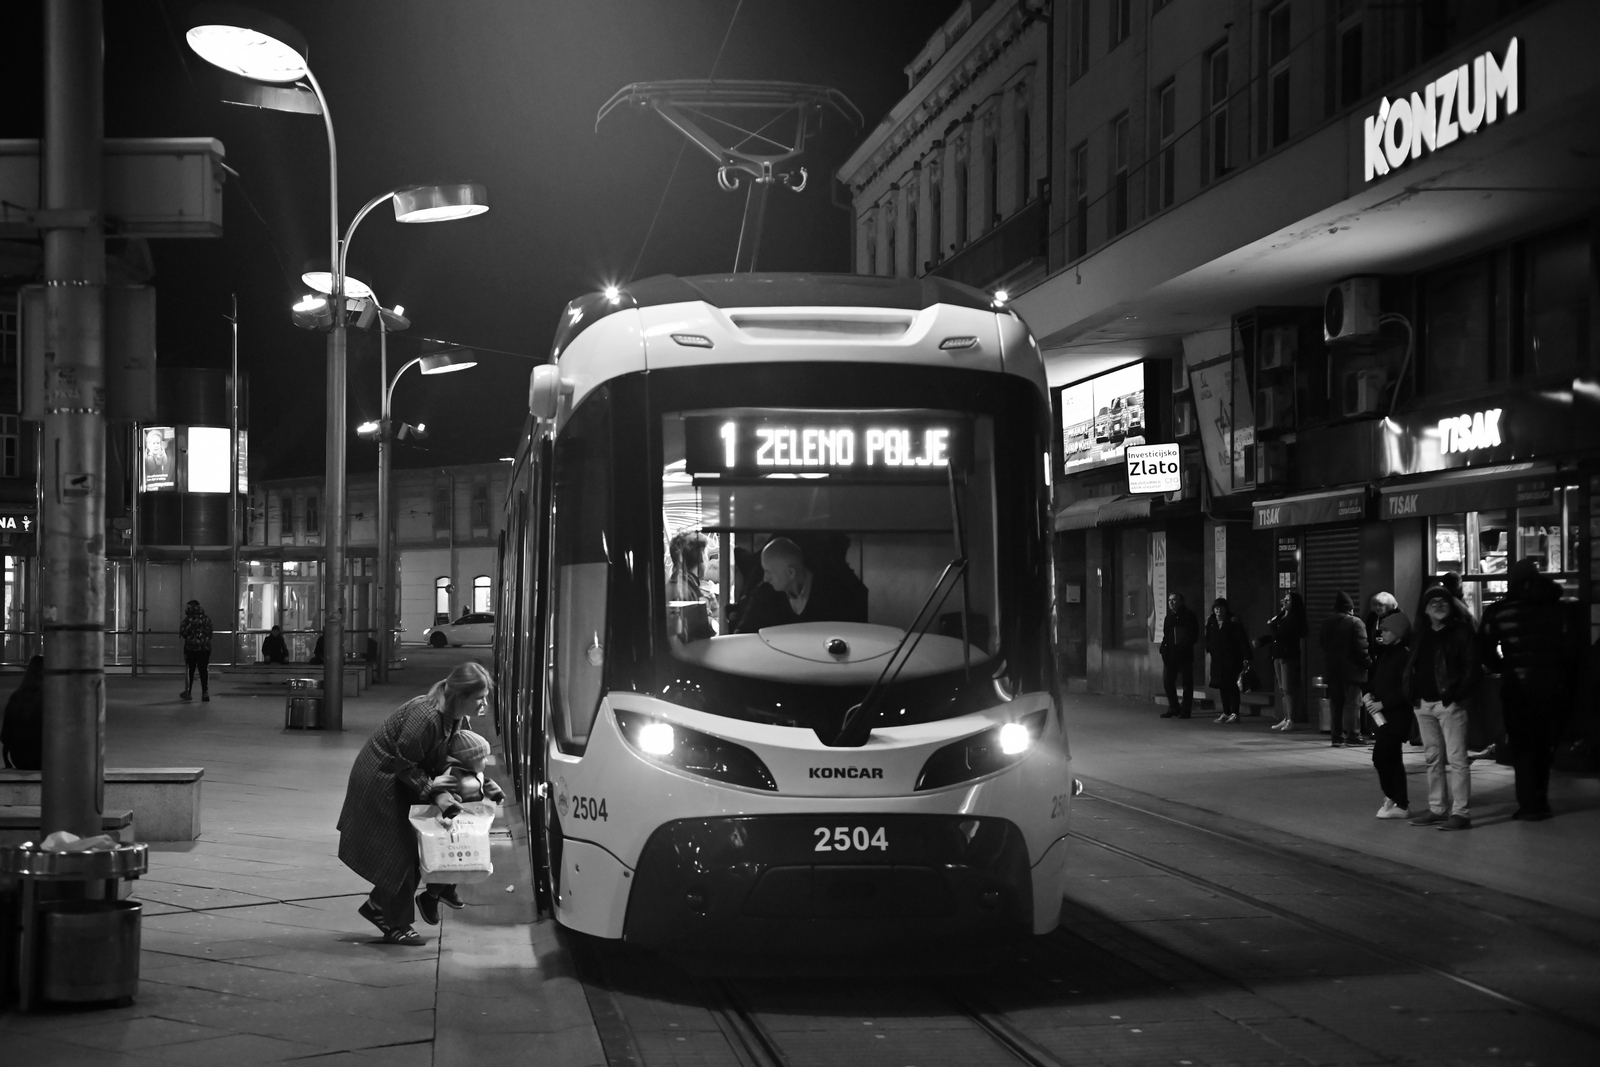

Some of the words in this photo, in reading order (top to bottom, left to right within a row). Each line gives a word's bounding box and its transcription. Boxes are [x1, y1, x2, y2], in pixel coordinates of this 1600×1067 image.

[1364, 36, 1518, 182] KONZUM
[1438, 408, 1502, 455] TISAK
[720, 421, 736, 468] 1
[755, 428, 855, 466] ZELENO
[865, 428, 950, 467] POLJE
[1128, 449, 1178, 459] Investicijsko
[1129, 459, 1179, 477] Zlato
[1389, 494, 1419, 515] TISAK
[1258, 507, 1281, 526] TISAK
[808, 765, 884, 779] KONČAR
[572, 795, 608, 822] 2504
[814, 826, 889, 852] 2504
